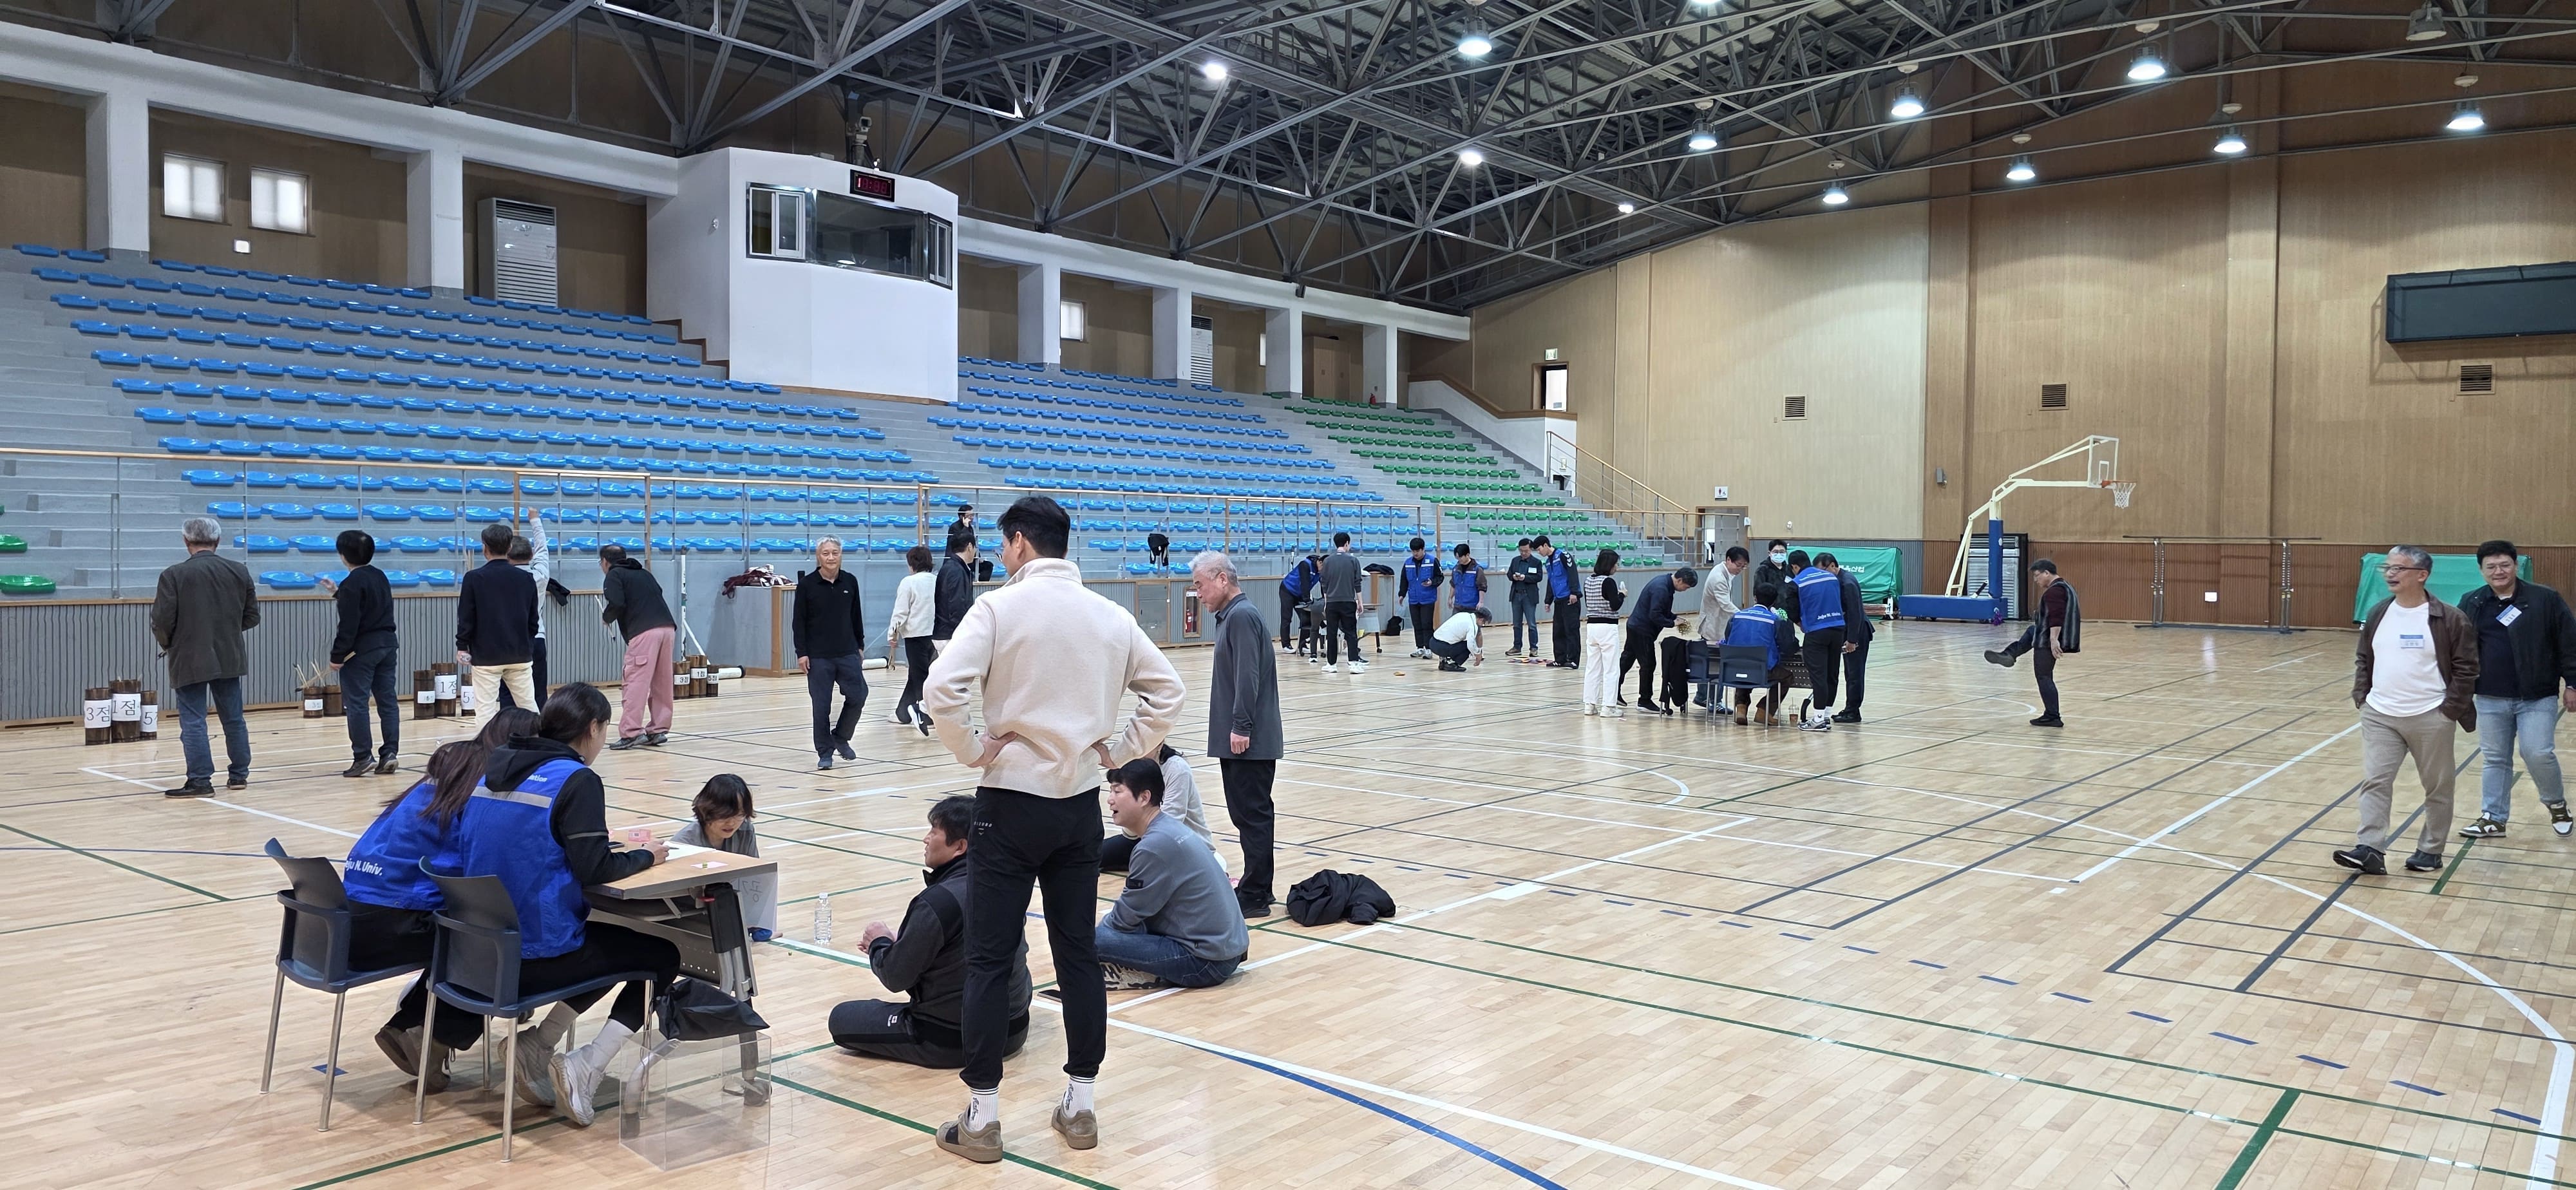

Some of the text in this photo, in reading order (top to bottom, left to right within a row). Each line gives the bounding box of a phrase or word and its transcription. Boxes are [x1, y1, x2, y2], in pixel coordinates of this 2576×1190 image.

[86, 705, 110, 722] 3점
[113, 699, 136, 716] 1점
[527, 774, 547, 782] ation
[345, 858, 383, 876] eju N. Univ.
